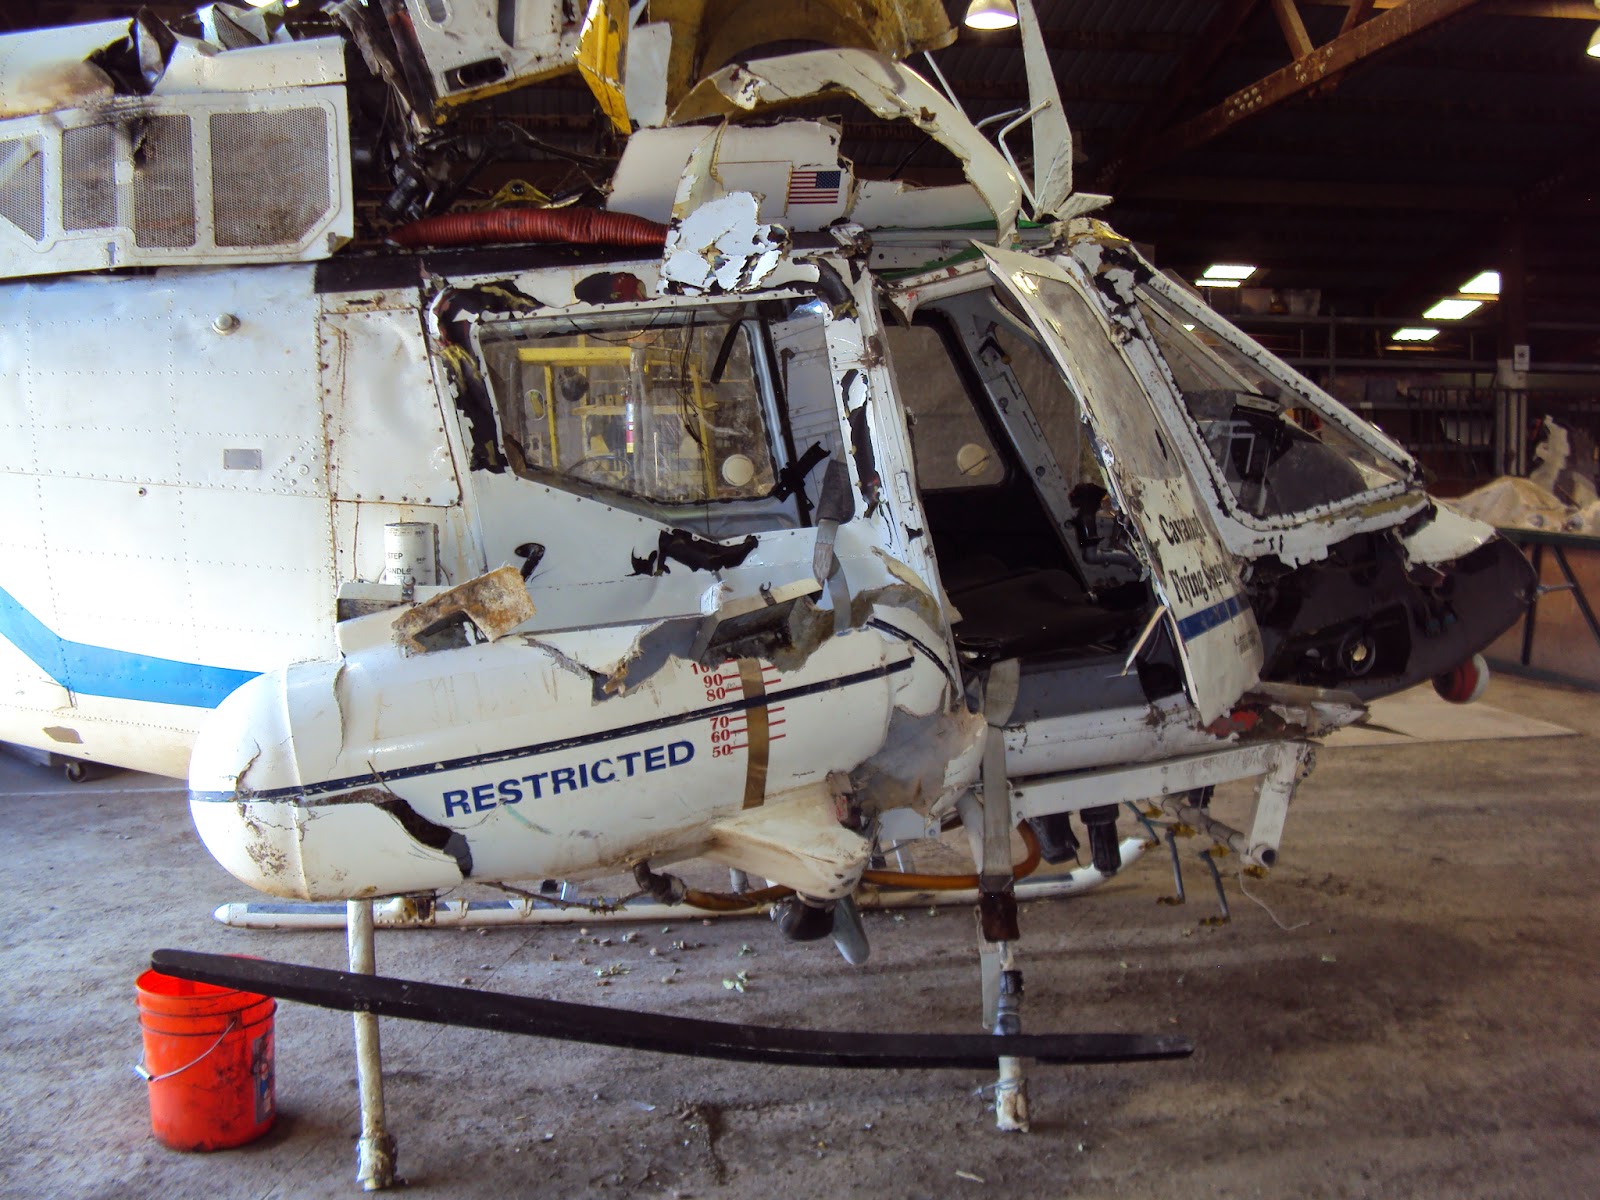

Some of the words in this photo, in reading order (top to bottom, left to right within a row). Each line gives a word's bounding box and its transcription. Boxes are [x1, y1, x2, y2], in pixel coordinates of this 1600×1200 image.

[1168, 565, 1209, 608] Flying
[703, 673, 723, 688] 90
[706, 687, 726, 702] 80
[709, 716, 730, 731] 70
[711, 729, 731, 744] 60
[712, 743, 732, 758] 50
[442, 740, 695, 818] RESTRICTED
